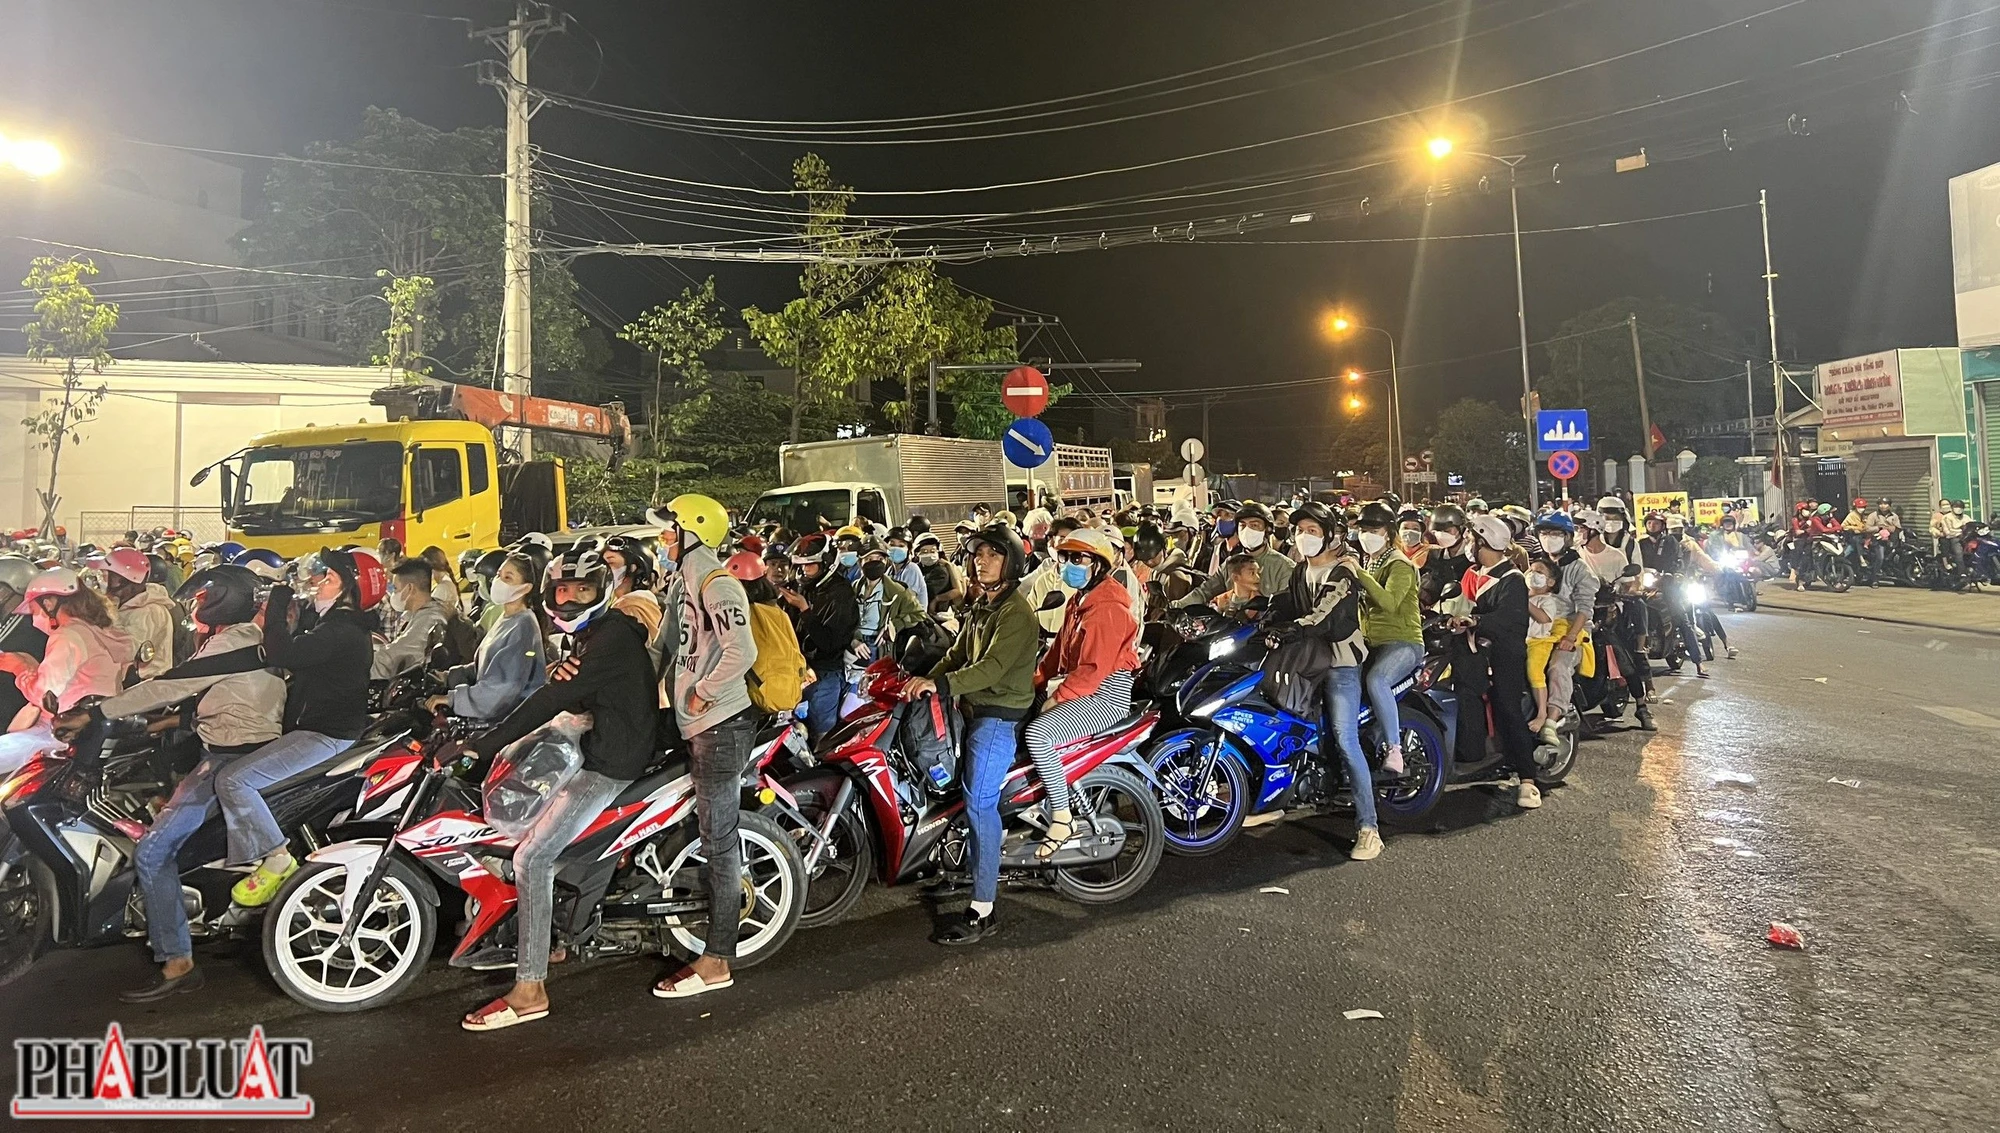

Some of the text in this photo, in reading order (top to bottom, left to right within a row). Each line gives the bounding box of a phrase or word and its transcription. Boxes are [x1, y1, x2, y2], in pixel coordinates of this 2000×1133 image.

[1391, 677, 1414, 696] YAMAHA
[1234, 711, 1253, 719] SPEED
[917, 817, 949, 836] HONDA
[410, 827, 499, 852] SONIC
